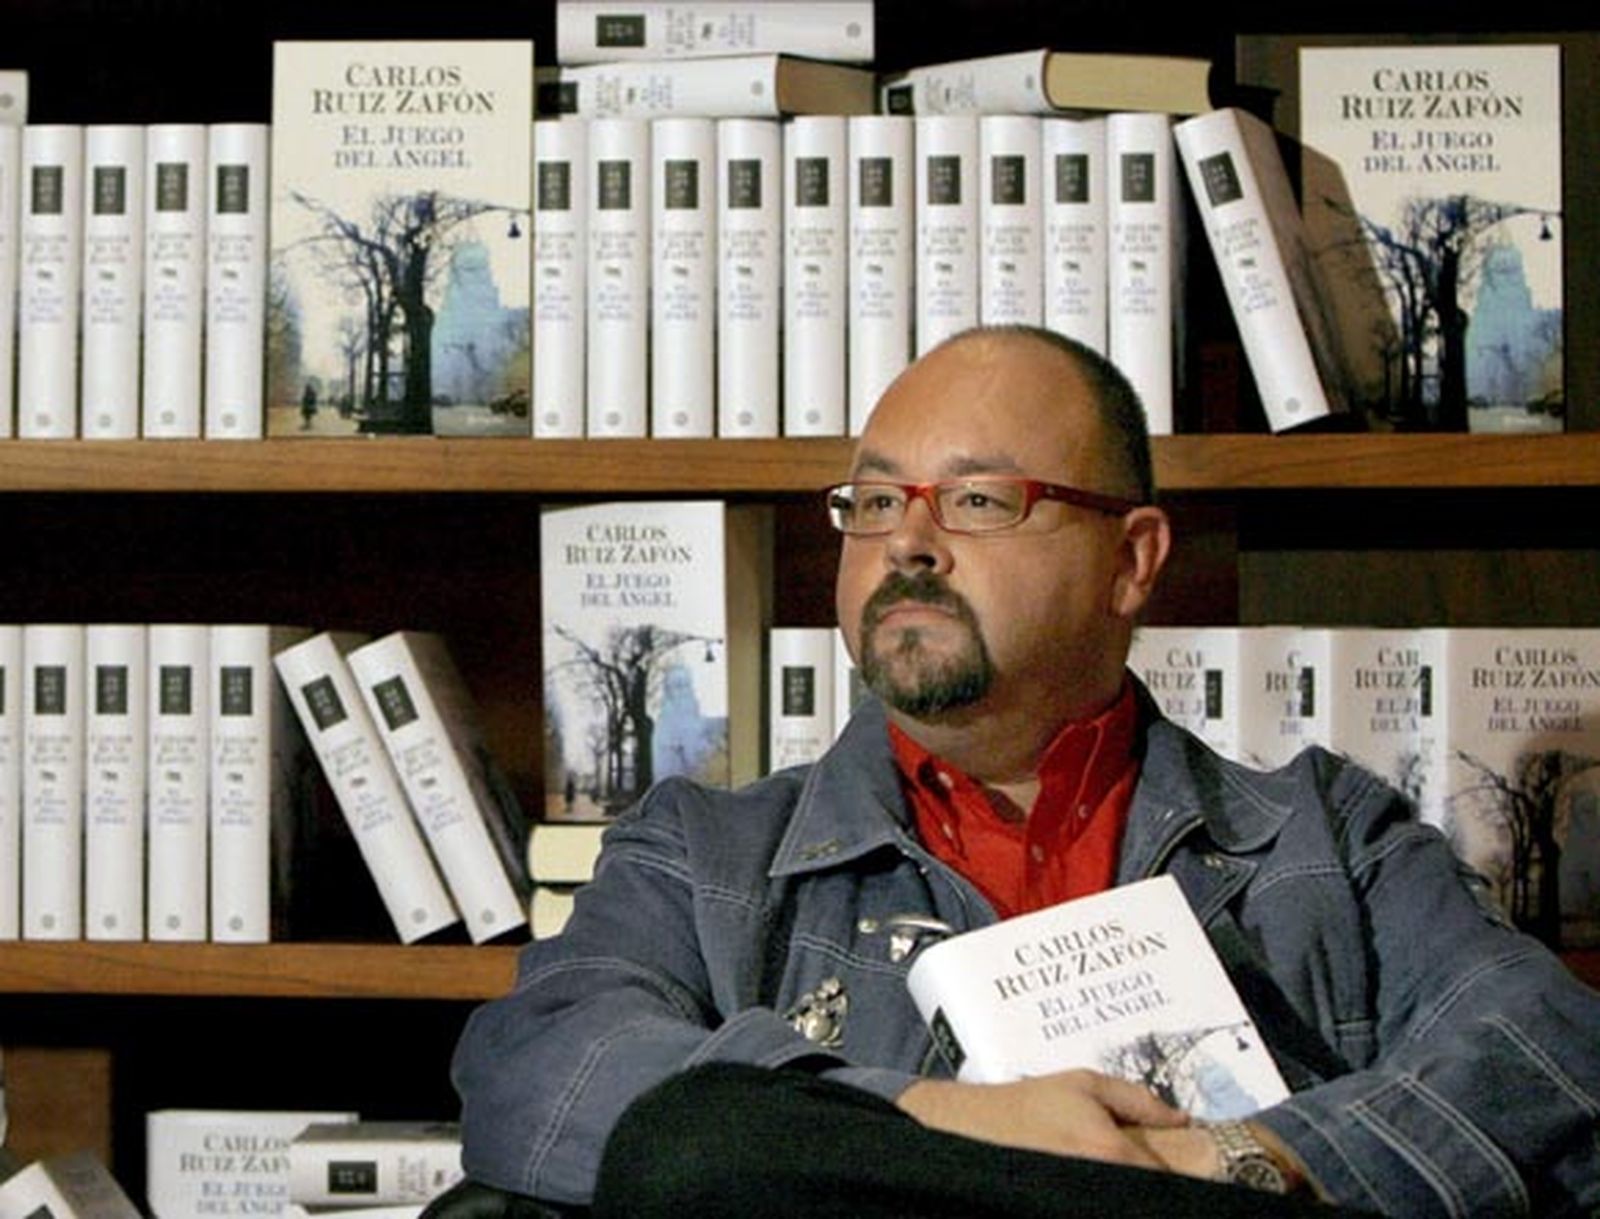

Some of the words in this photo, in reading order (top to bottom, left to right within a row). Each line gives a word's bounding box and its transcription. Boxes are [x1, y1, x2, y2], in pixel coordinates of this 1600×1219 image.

[345, 64, 462, 87] CARLOS
[1373, 69, 1490, 92] CARLOS
[312, 89, 386, 114] RUIZ
[1341, 95, 1414, 119] RUIZ
[342, 125, 375, 145] EL
[382, 125, 465, 147] JUEGO
[1372, 131, 1405, 150] EL
[1411, 131, 1494, 150] JUEGO
[335, 149, 376, 169] DEL
[1364, 155, 1411, 173] DEL
[586, 524, 666, 543] CARLOS
[566, 544, 616, 564] RUIZ
[586, 573, 608, 589] EL
[614, 573, 671, 590] JUEGO
[1495, 646, 1578, 667] CARLOS
[1355, 668, 1406, 689] RUIZ
[1473, 667, 1525, 688] RUIZ
[1494, 697, 1518, 714] EL
[1523, 697, 1580, 714] JUEGO
[1014, 920, 1125, 966] CARLOS
[994, 963, 1068, 1001] RUIZ
[1039, 997, 1074, 1019] EL
[1076, 971, 1153, 1007] JUEGO
[1042, 1015, 1090, 1041] DEL
[180, 1153, 234, 1172] RUIZ
